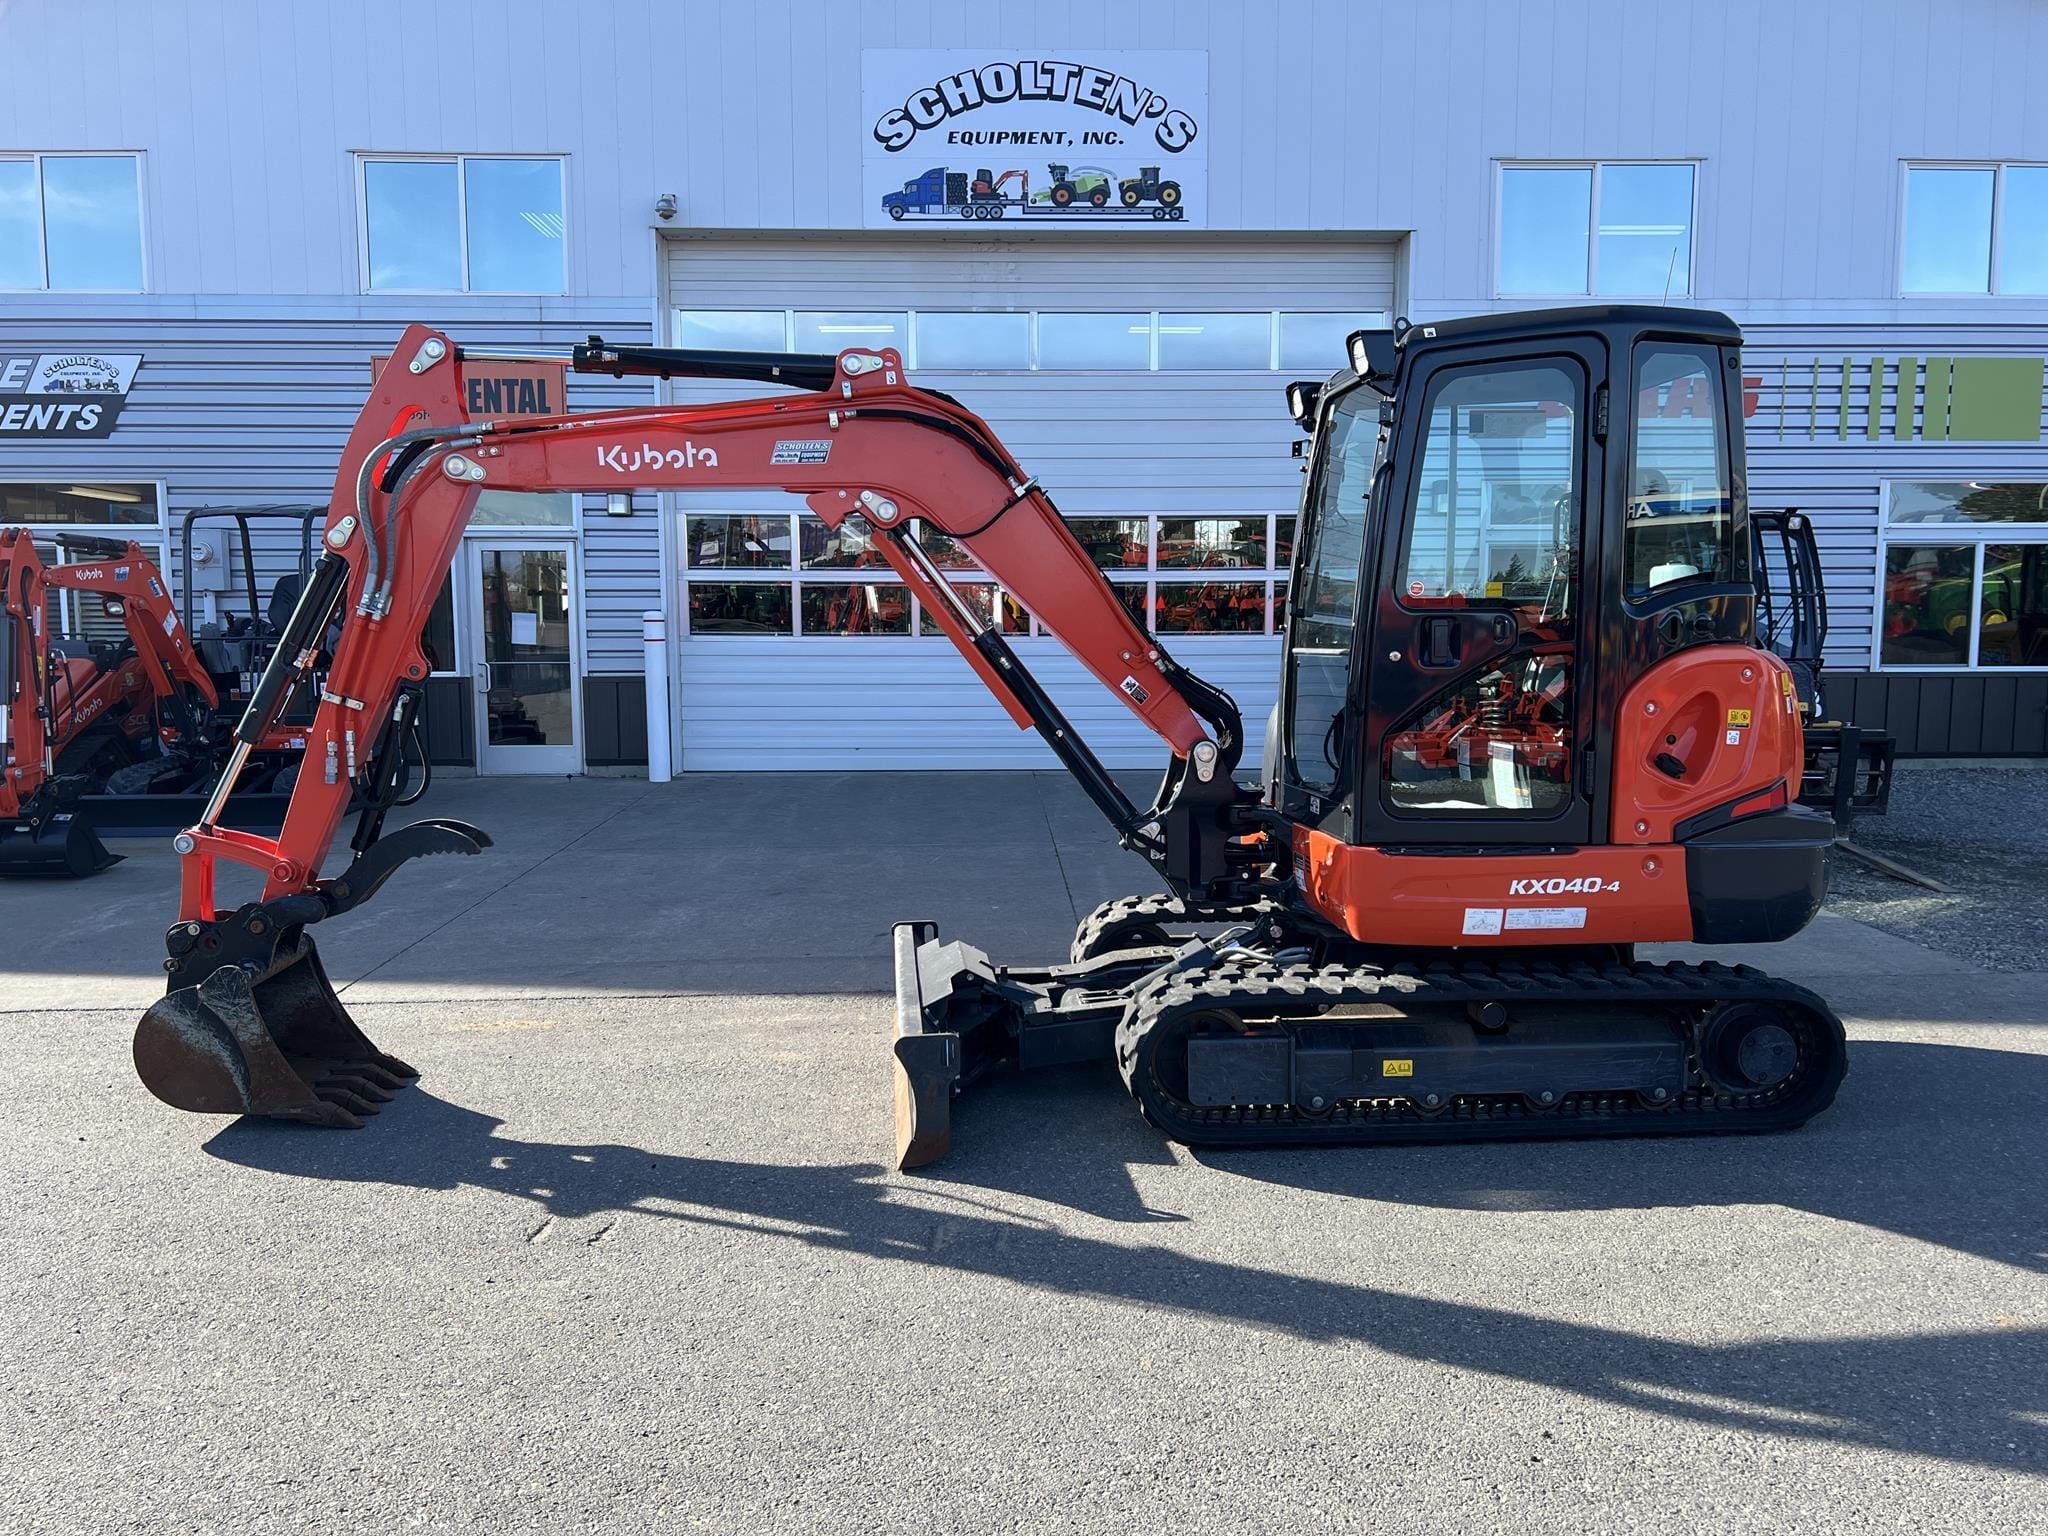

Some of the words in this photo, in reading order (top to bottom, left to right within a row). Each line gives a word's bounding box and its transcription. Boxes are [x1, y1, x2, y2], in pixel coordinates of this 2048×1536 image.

[874, 61, 1197, 153] SCHOLTEN'S
[947, 131, 1074, 146] EQUIPMENT,
[1083, 131, 1124, 145] INC.
[0, 358, 33, 388] E
[44, 356, 119, 378] SCHOLTEN'S
[463, 378, 551, 414] ENTAL
[597, 440, 718, 472] Kubota
[75, 568, 103, 580] Kubota
[75, 697, 103, 723] Kubota
[1509, 877, 1620, 895] KX040-4
